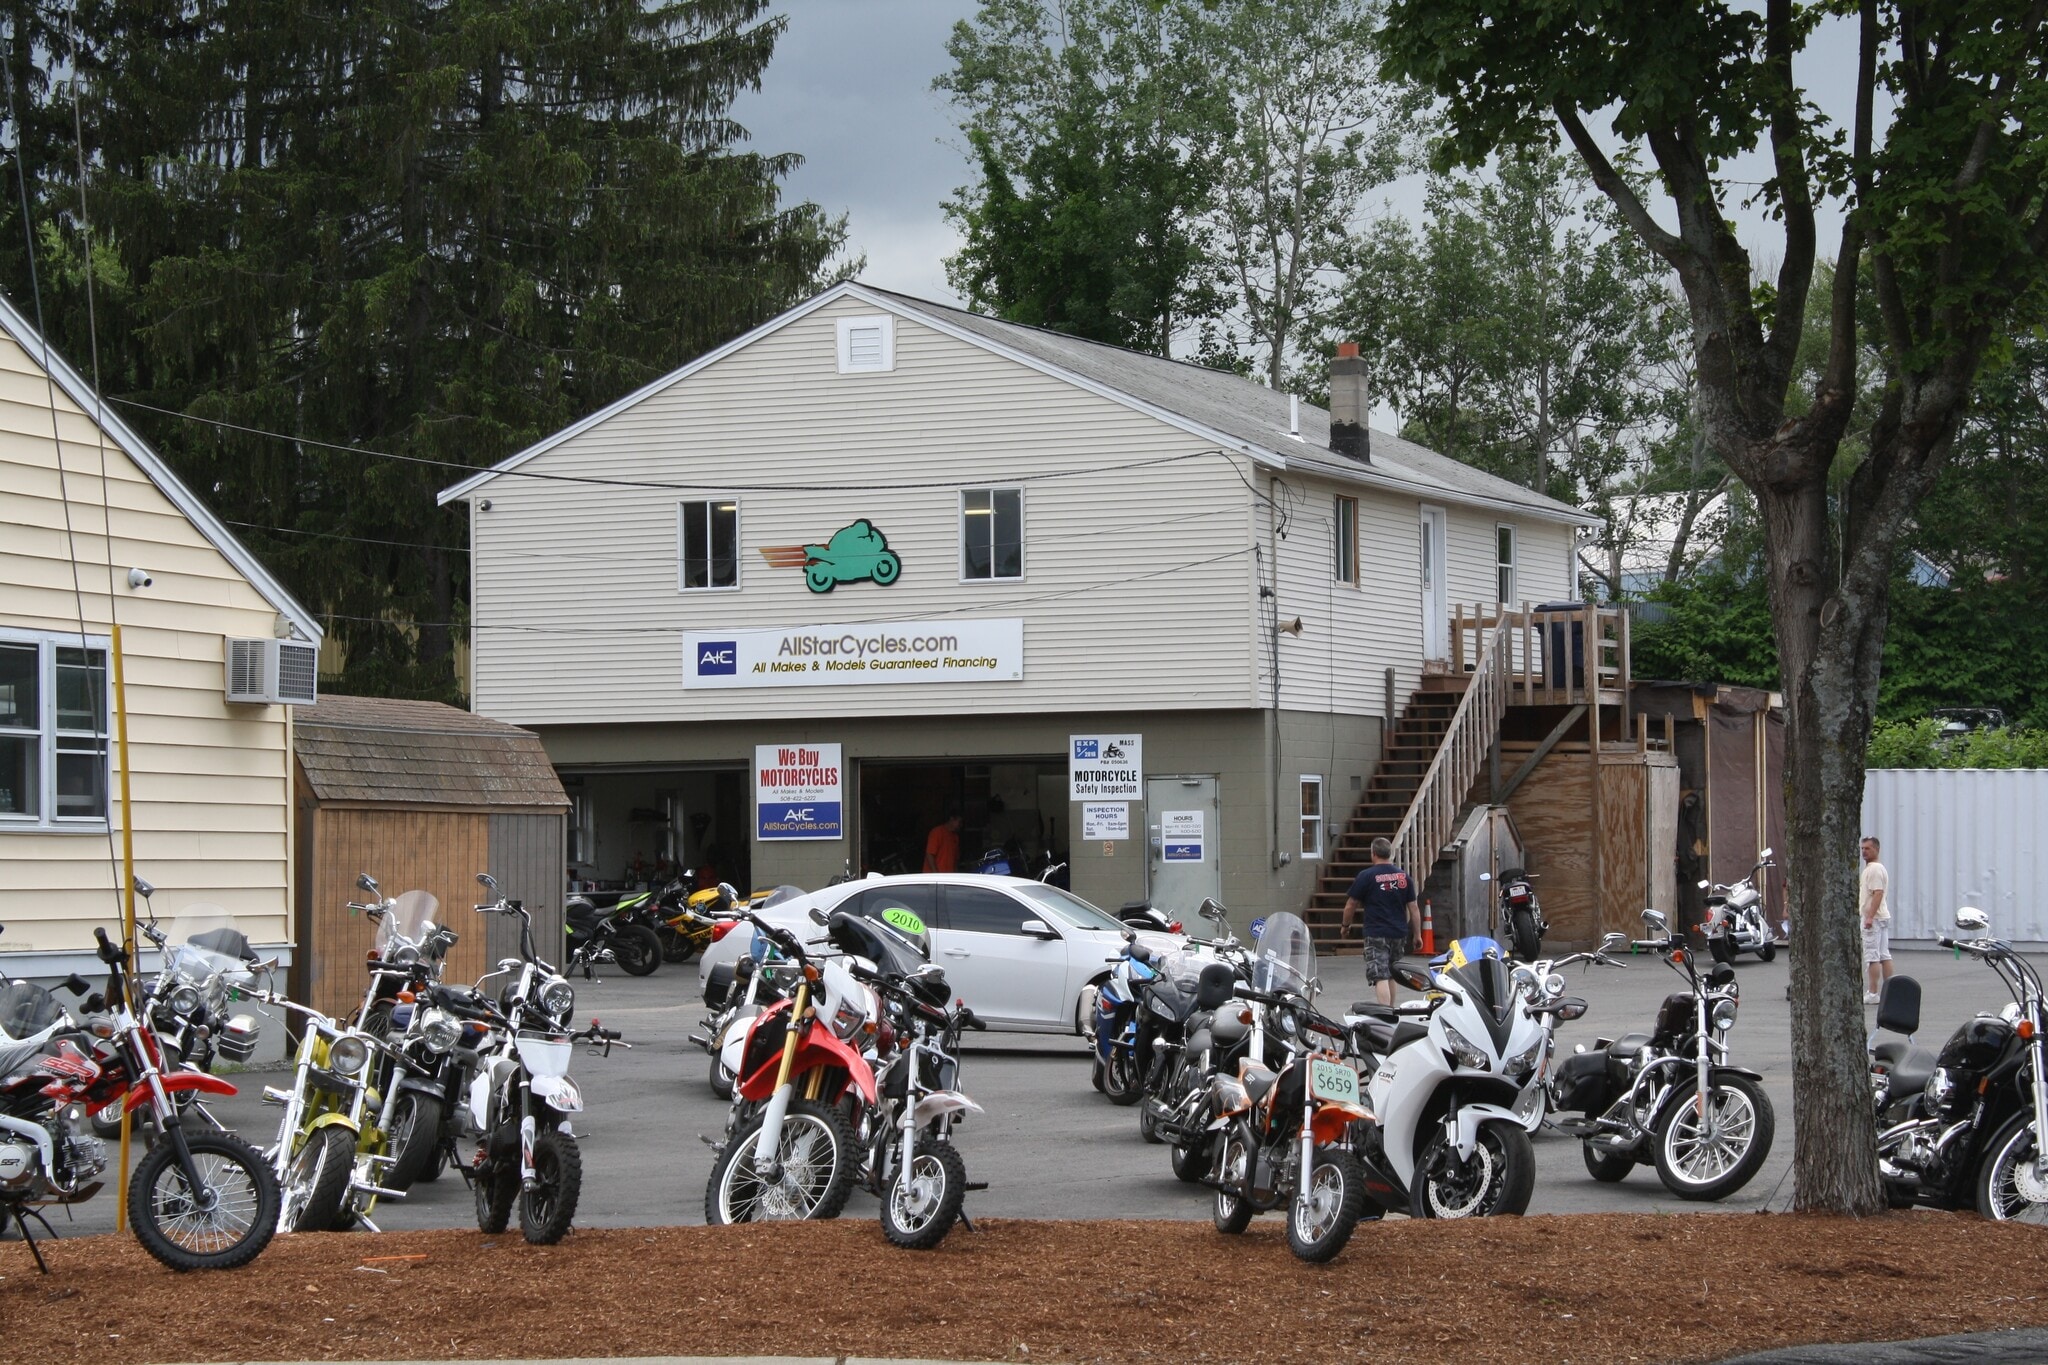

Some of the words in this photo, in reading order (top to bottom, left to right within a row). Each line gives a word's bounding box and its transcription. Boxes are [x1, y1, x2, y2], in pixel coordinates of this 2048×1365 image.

[778, 634, 958, 658] AllStarCycles.com
[752, 662, 766, 673] All
[770, 661, 806, 673] Makes
[811, 661, 820, 671] &
[826, 659, 866, 671] Models
[869, 657, 939, 670] Guaranteed
[942, 656, 998, 669] Financing
[778, 749, 796, 766] We
[798, 748, 819, 767] Buy
[760, 767, 838, 787] MOTORCYCLES
[1074, 770, 1137, 782] MOTORCYCLE
[1075, 783, 1098, 795] Safety
[1101, 783, 1137, 795] Inspection
[763, 822, 838, 831] AllStarCycles.com
[891, 912, 920, 931] 2010
[40, 1056, 95, 1082] SSR
[1317, 1063, 1333, 1074] 2015
[1335, 1068, 1351, 1077] SR70
[1318, 1072, 1352, 1094] $659
